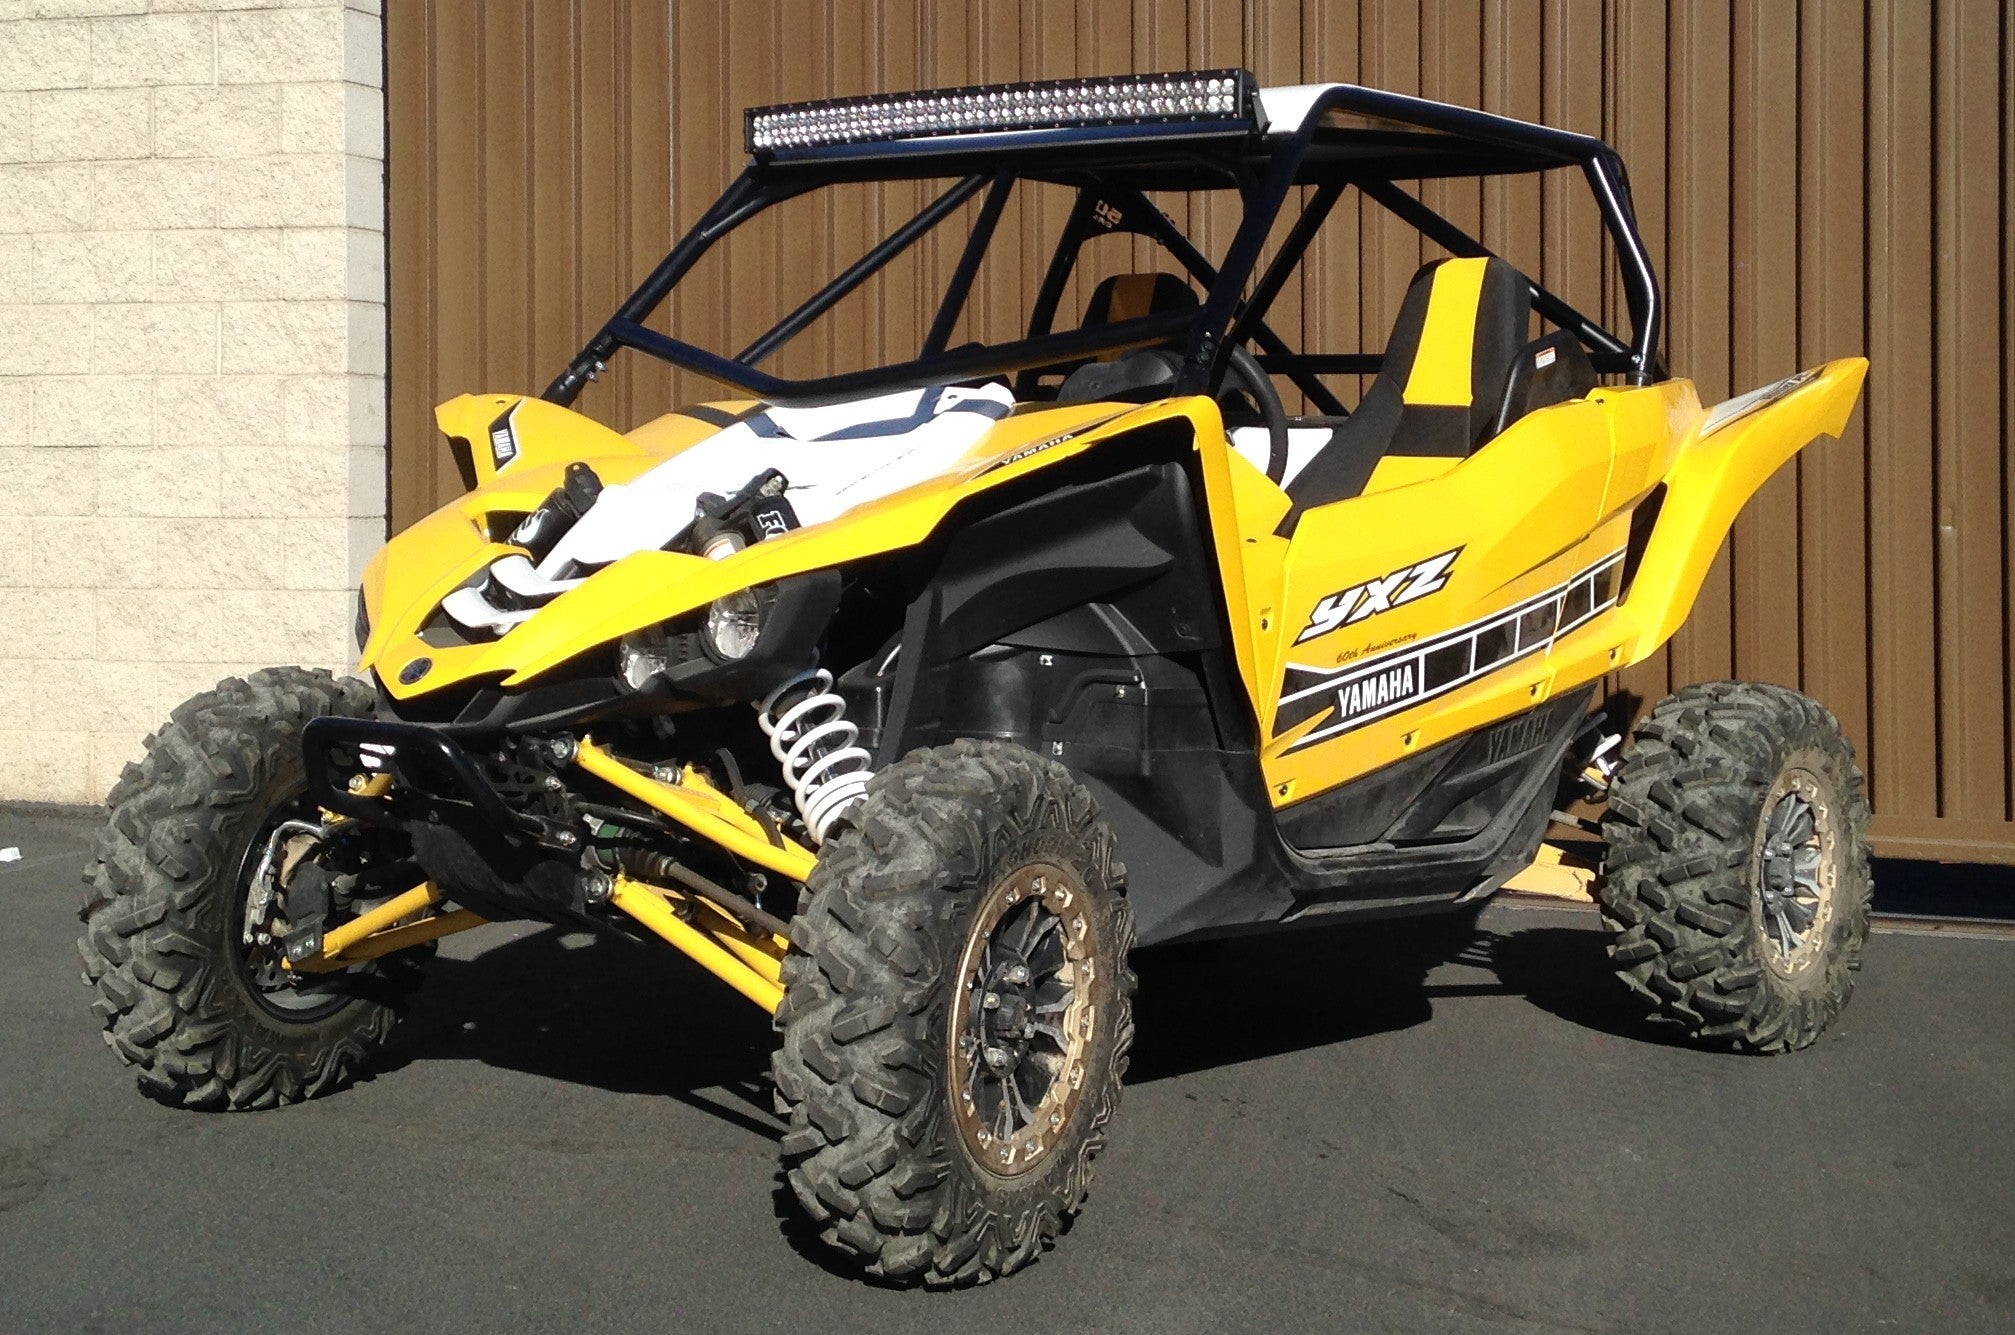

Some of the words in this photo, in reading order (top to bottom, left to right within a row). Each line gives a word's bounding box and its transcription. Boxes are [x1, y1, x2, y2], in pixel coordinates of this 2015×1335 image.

[1001, 433, 1075, 465] YAMAHA
[1360, 632, 1418, 656] Anniversary
[1337, 664, 1415, 718] YAMAHA
